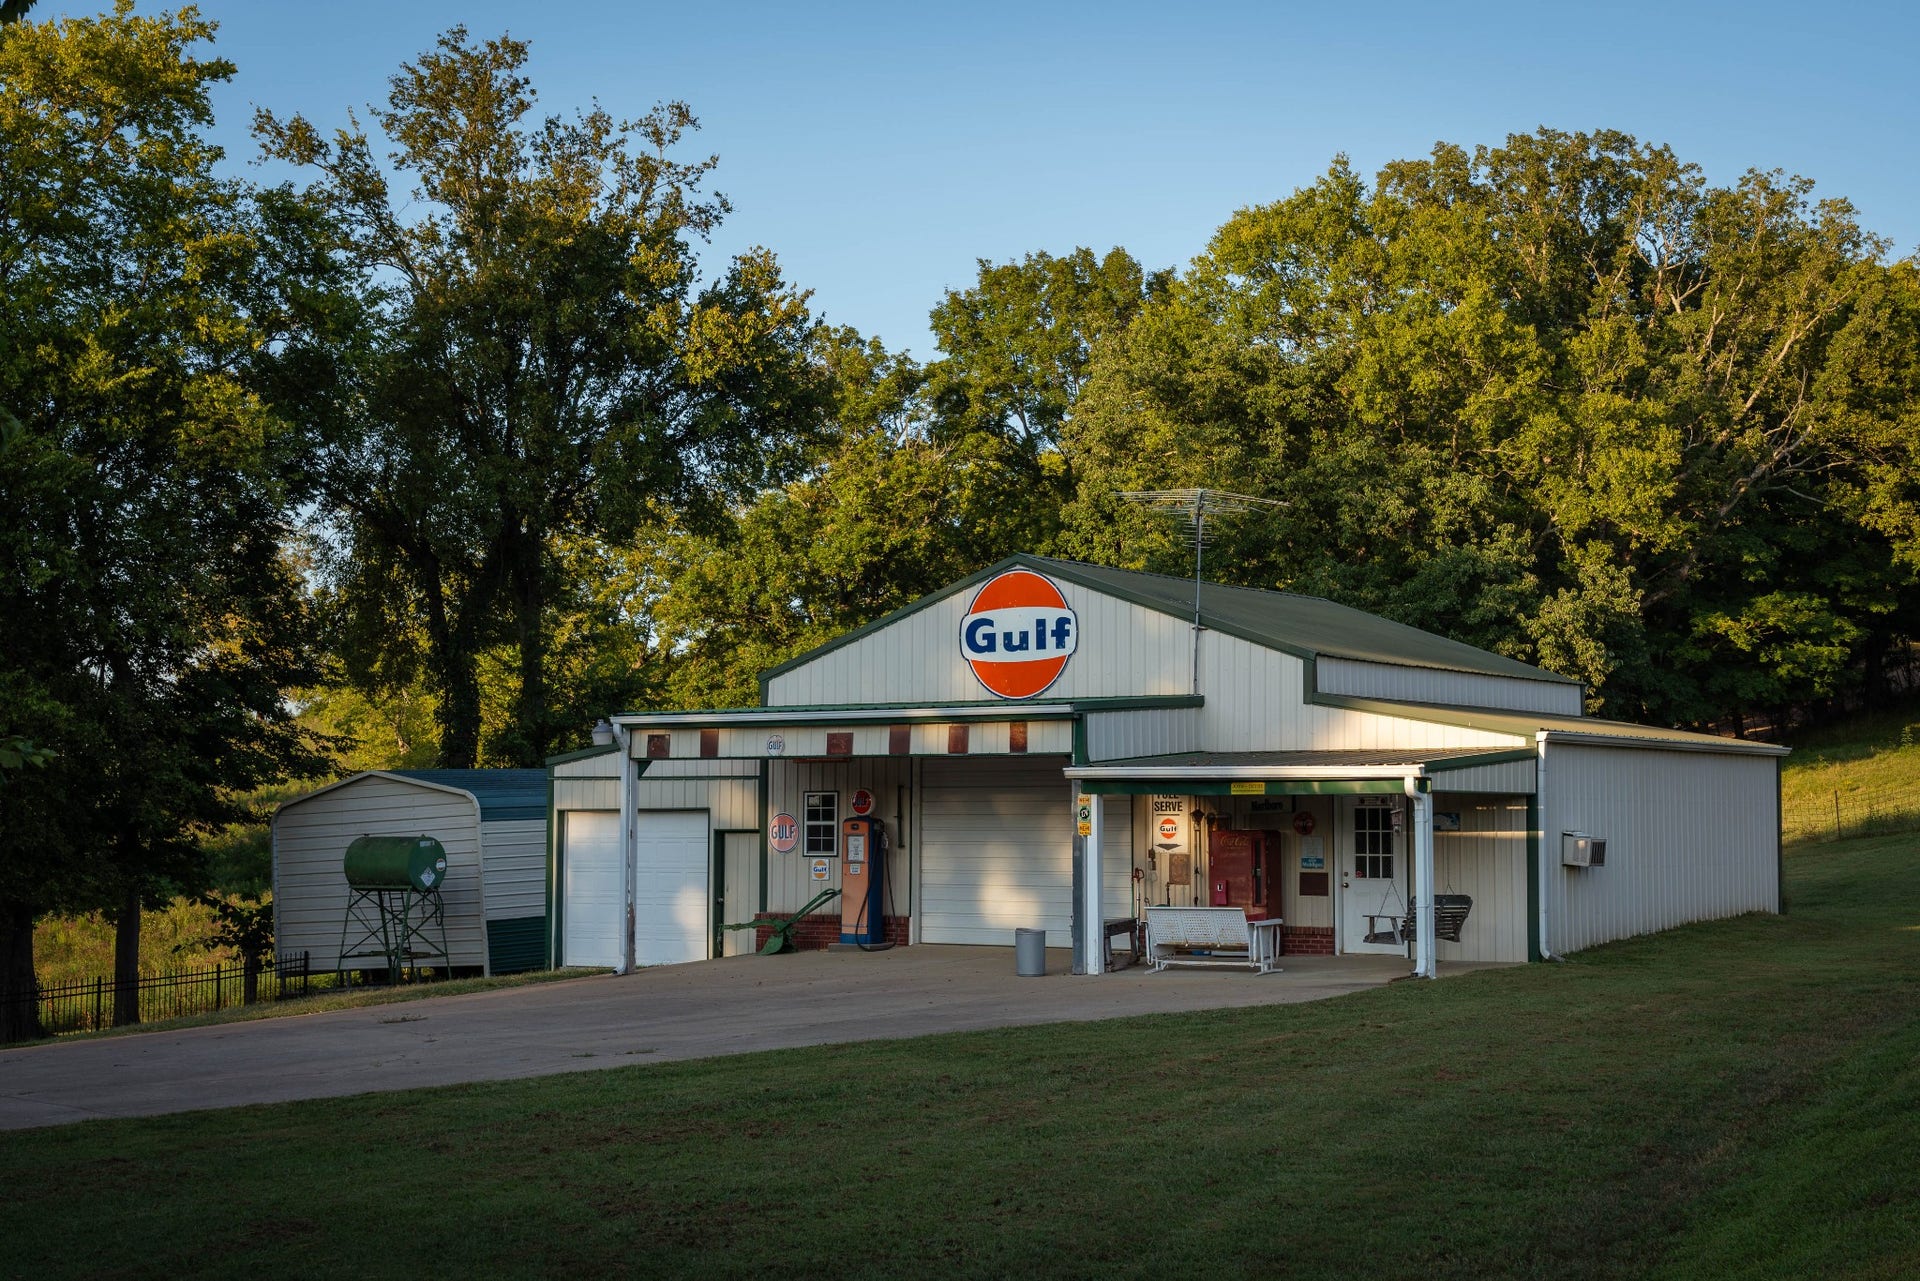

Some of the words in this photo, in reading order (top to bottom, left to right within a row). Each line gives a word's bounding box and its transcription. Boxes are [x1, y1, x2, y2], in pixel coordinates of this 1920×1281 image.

[965, 616, 1072, 654] Gulf
[768, 740, 783, 750] GULF
[1154, 801, 1183, 811] SERVE
[771, 824, 796, 840] GULF
